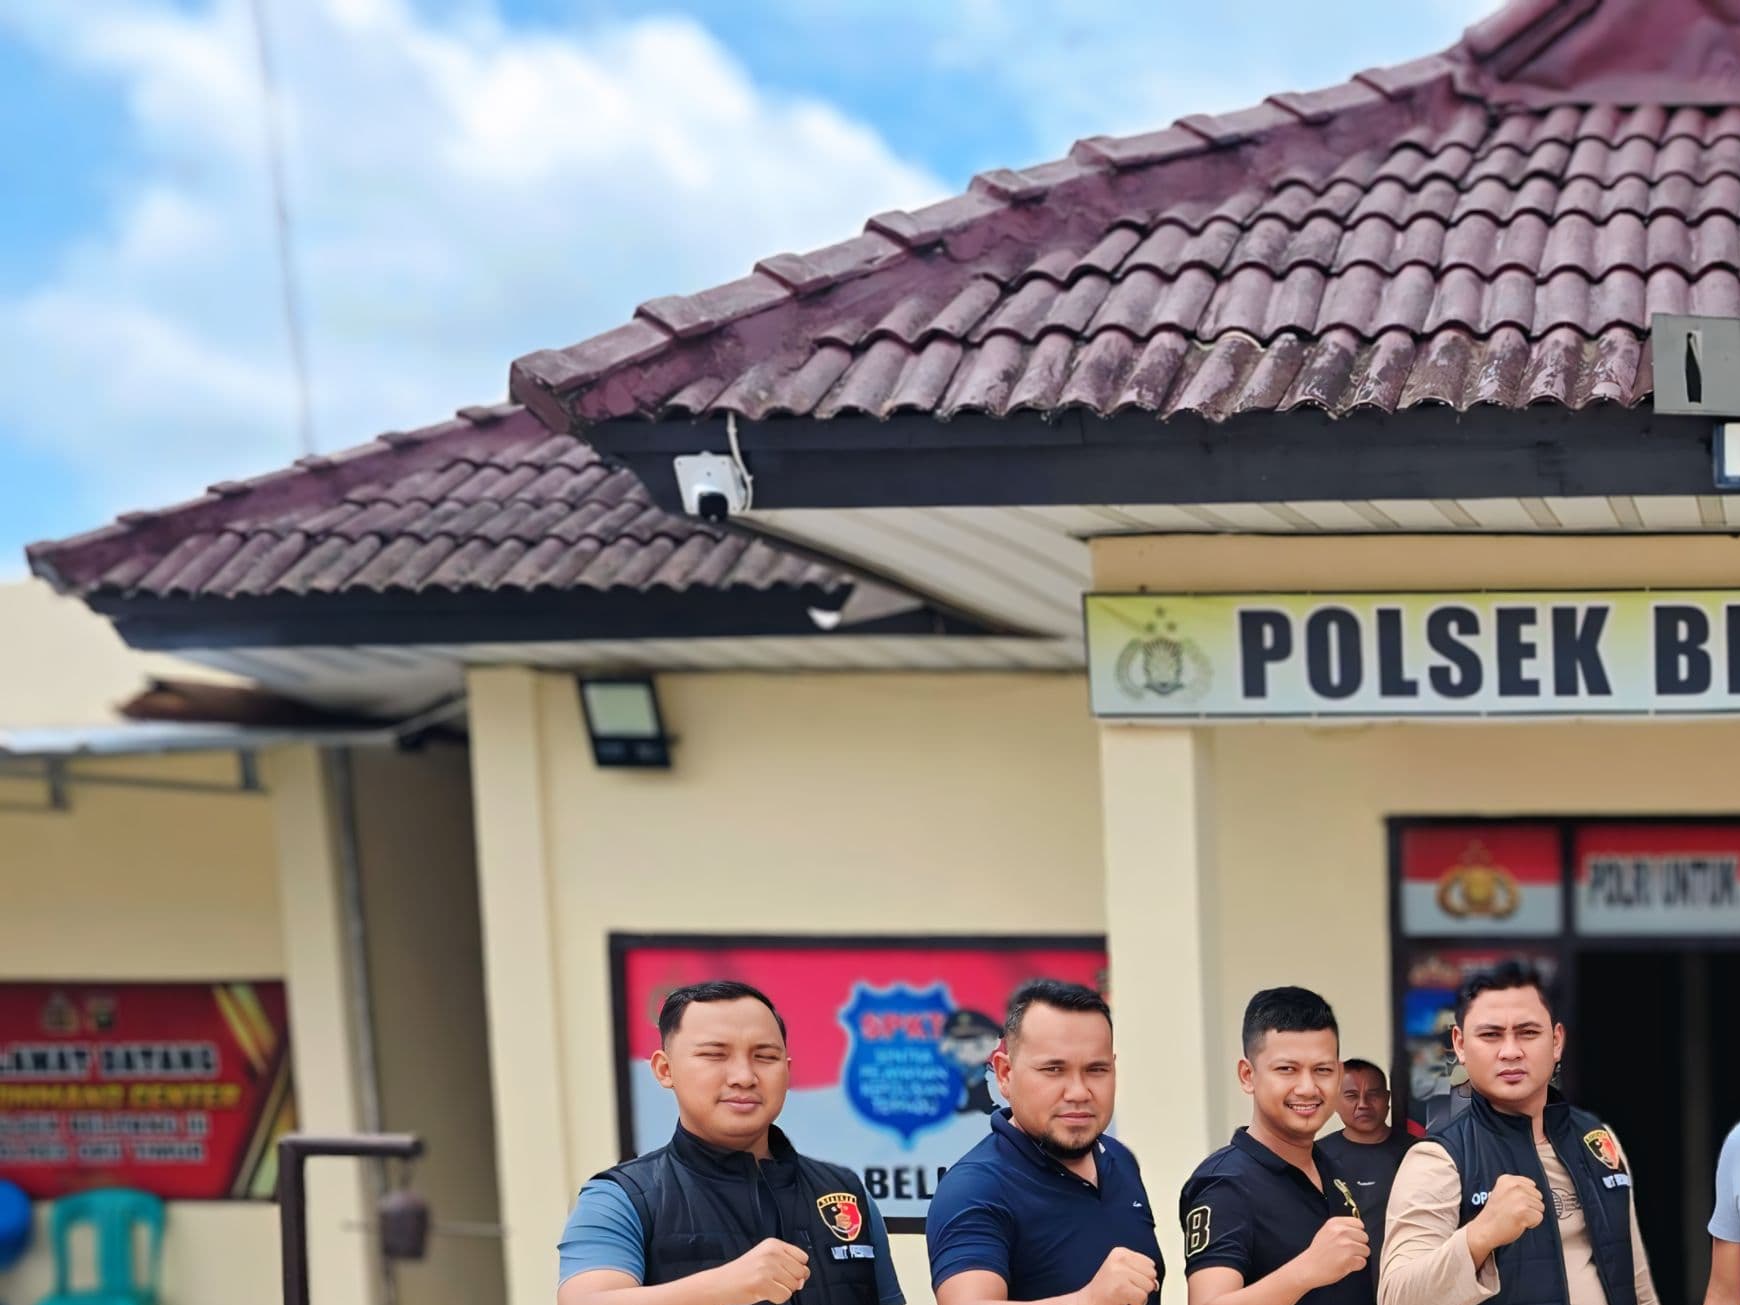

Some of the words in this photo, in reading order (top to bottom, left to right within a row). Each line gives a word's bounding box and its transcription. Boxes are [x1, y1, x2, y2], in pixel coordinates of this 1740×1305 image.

[1238, 605, 1613, 700] POLSEK
[1589, 856, 1652, 907] POLRI
[1661, 855, 1738, 907] UNTUK
[1472, 1191, 1492, 1206] OP
